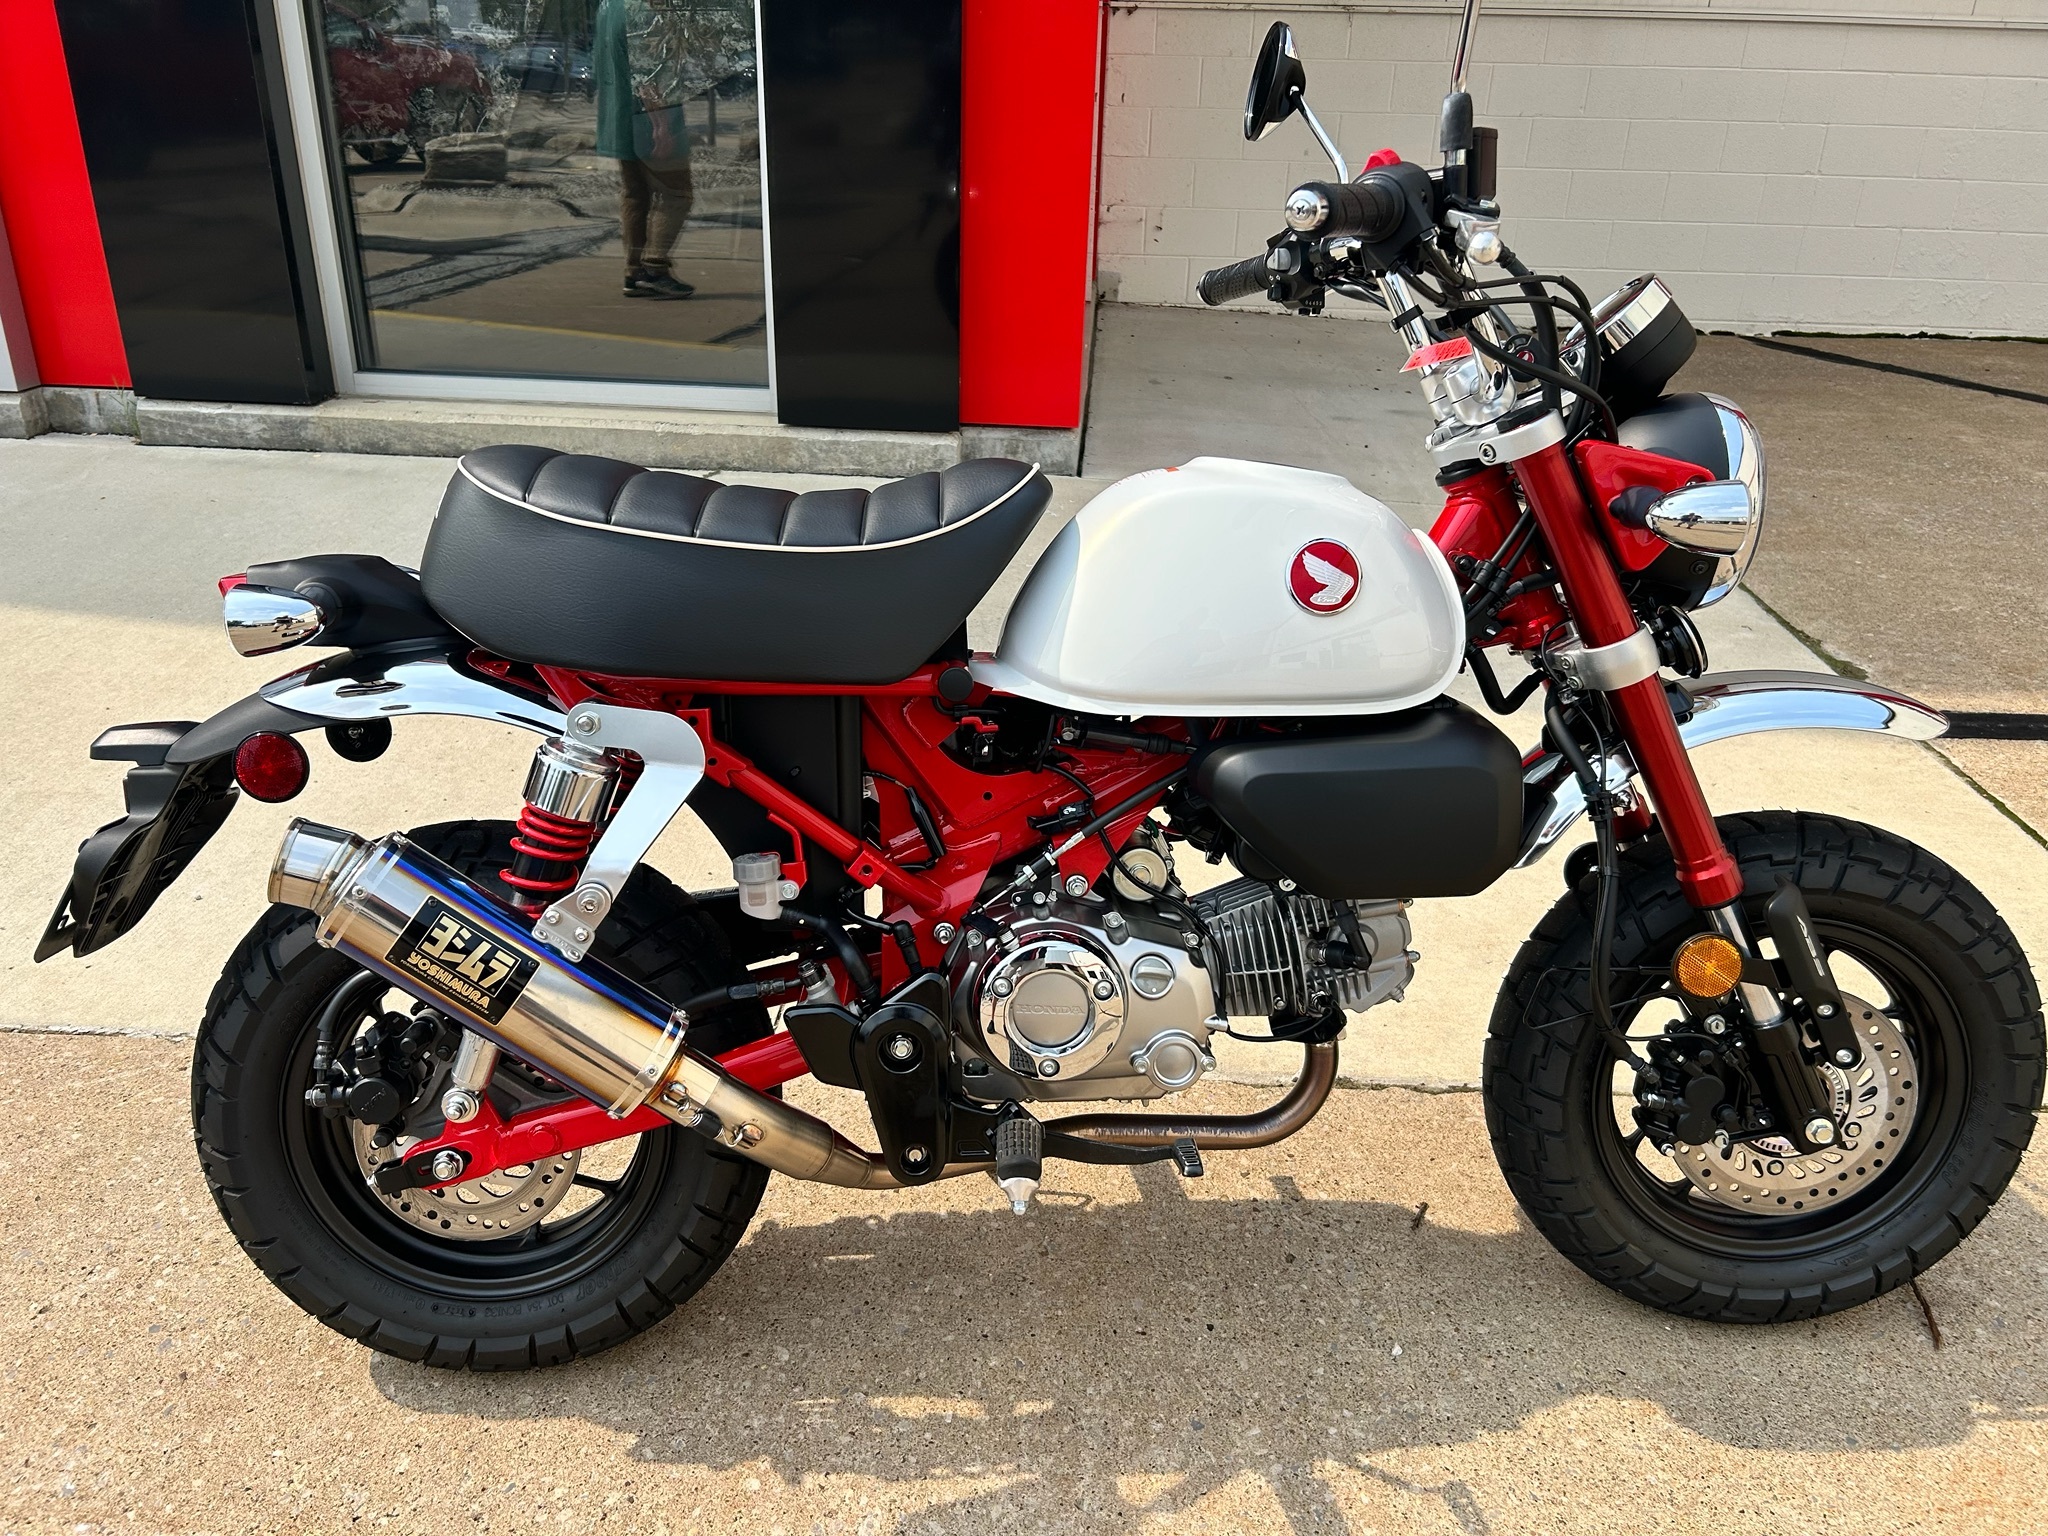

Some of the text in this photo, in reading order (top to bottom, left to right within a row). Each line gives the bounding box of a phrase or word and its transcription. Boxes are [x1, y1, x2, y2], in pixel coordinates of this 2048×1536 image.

[407, 951, 490, 1009] YOSHIMURA
[420, 915, 517, 989] ヨシムラ
[1016, 1003, 1086, 1016] HONDA
